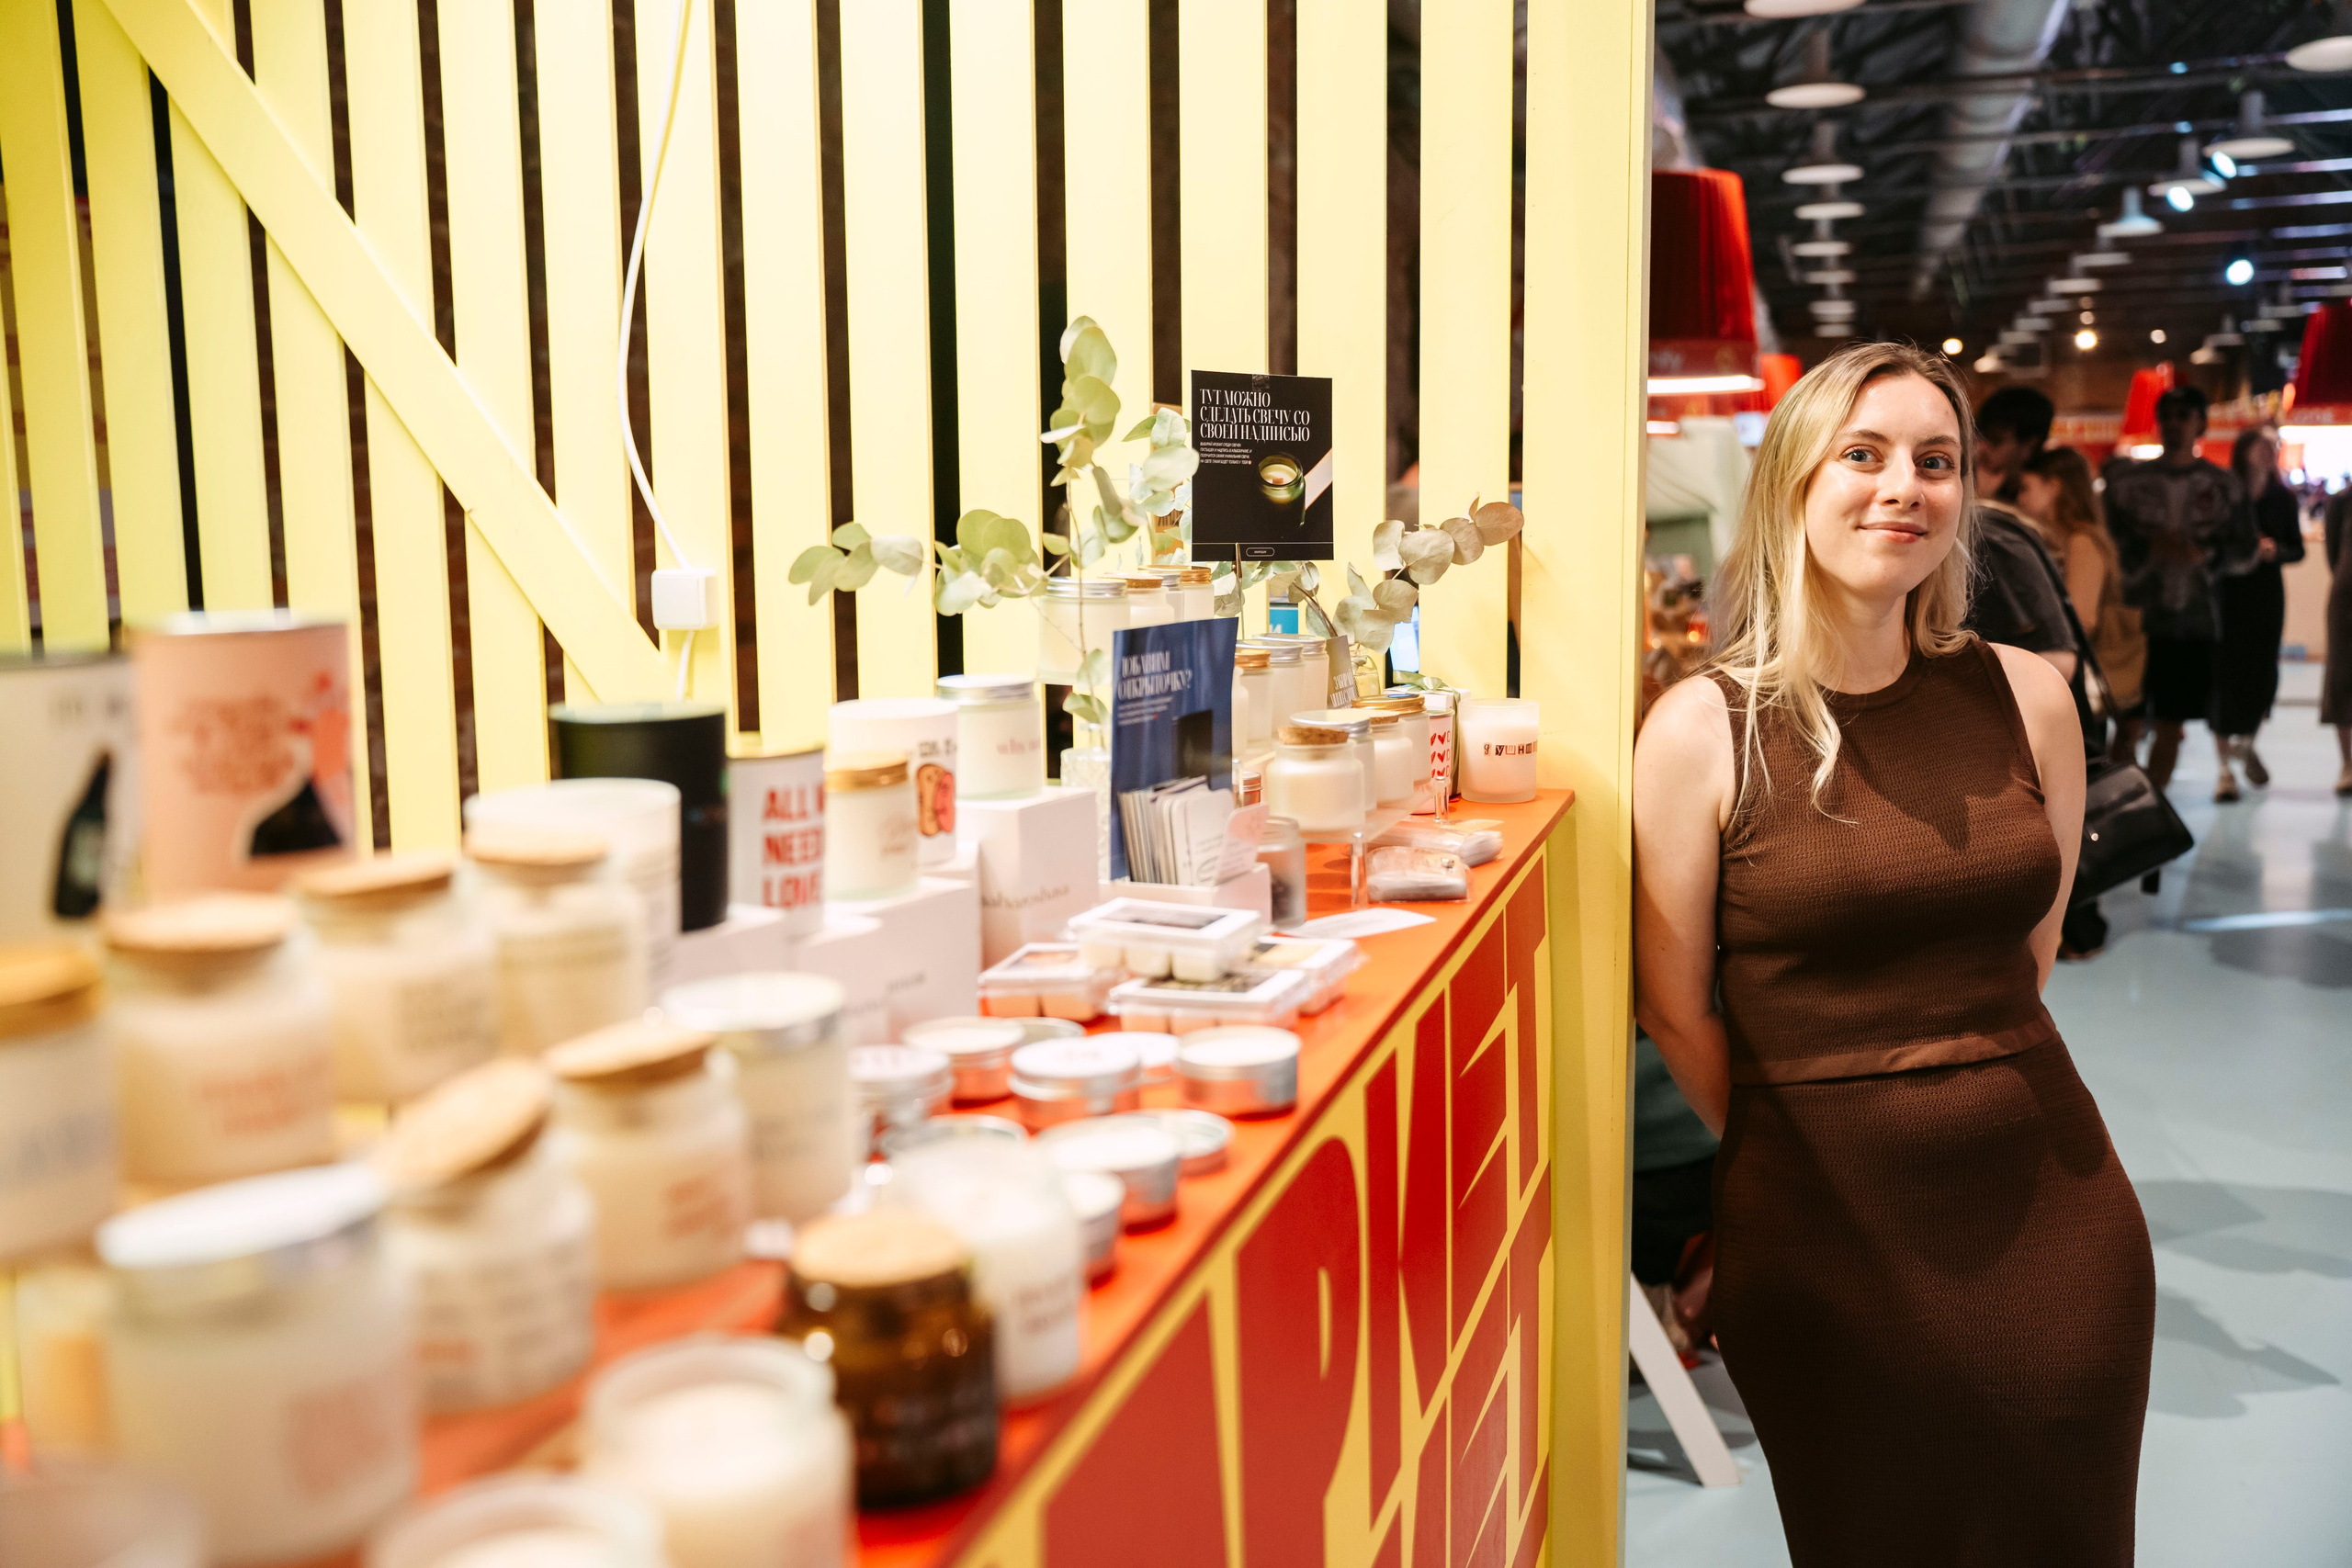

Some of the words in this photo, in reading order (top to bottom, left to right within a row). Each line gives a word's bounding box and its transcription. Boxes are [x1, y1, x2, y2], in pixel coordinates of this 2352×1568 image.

[1200, 389, 1221, 405] ТУТ
[1224, 390, 1271, 407] МОЖНО
[1200, 406, 1250, 424] СДЕЛАТЬ
[1253, 409, 1291, 424] СВЕЧУ
[1294, 410, 1310, 425] СО
[1200, 423, 1238, 440] СВОЕЙ
[1240, 424, 1310, 444] НАДПИСЬЮ
